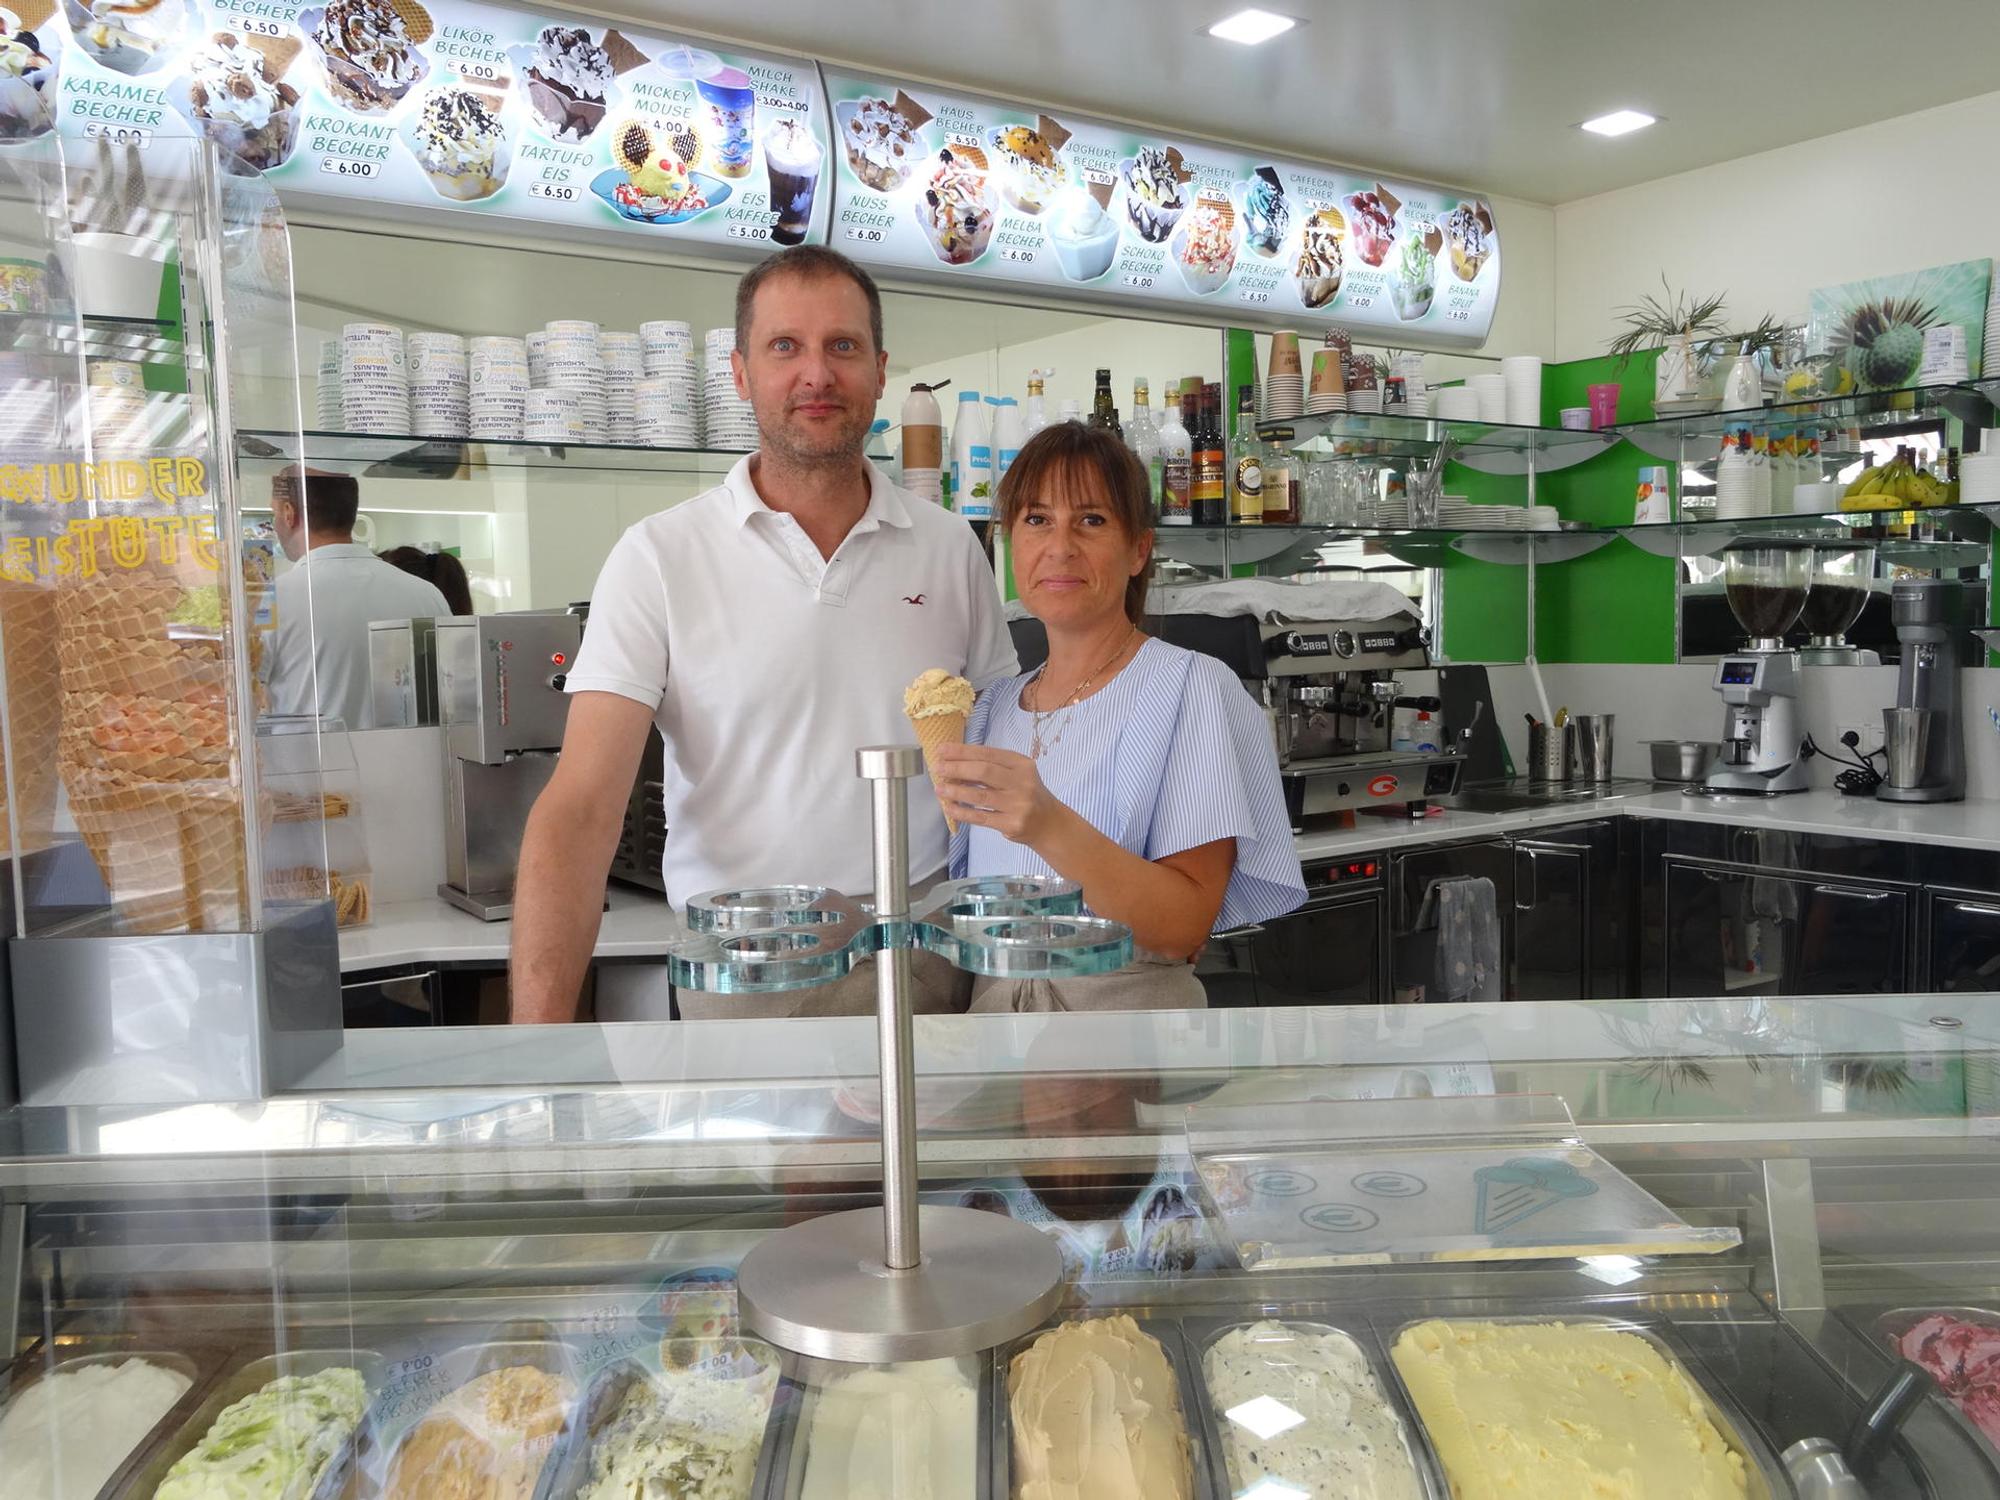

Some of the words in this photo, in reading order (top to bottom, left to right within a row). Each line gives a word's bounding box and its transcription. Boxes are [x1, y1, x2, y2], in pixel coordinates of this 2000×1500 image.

[243, 19, 279, 36] 6.50
[442, 26, 495, 46] LIKÖR
[435, 41, 506, 64] BECHER
[460, 63, 494, 79] 6.00
[747, 66, 793, 82] MILCH
[63, 76, 167, 106] KARAMEL
[632, 82, 692, 102] MICKEY
[749, 80, 796, 97] SHAKE
[72, 99, 163, 126] BECHER
[634, 100, 693, 119] MOUSE
[940, 105, 975, 120] HAUS
[305, 115, 398, 141] KROKANT
[653, 119, 683, 134] 4.00
[935, 118, 986, 135] BECHER
[312, 136, 390, 160] BECHER
[956, 135, 978, 146] 6.50
[520, 144, 594, 167] TARTUFO
[1065, 142, 1118, 160] JOGHURT
[323, 159, 333, 170] €
[339, 162, 372, 176] 6.00
[1072, 156, 1118, 173] BECHER
[1181, 160, 1236, 179] SPAGHETTI
[542, 166, 570, 181] EIS
[1090, 173, 1111, 184] 6.00
[1191, 175, 1233, 191] BECHER
[544, 185, 573, 200] 6.50
[741, 192, 766, 207] EIS
[1297, 186, 1334, 201] BECHER
[849, 195, 889, 211] NUSS
[724, 207, 780, 226] KAFFEE
[841, 210, 896, 228] BECHER
[740, 227, 768, 240] 5.00
[1001, 217, 1043, 234] MELBA
[857, 230, 882, 242] 6.00
[996, 232, 1046, 249] BECHER
[1010, 250, 1034, 262] 6.00
[1121, 245, 1166, 260] SCHOKO
[1119, 260, 1164, 275] BECHER
[1132, 276, 1153, 287] 6.00
[1239, 276, 1279, 290] BECHER
[1346, 282, 1383, 296] BECHER
[1249, 292, 1268, 303] 6.50
[1448, 284, 1481, 297] BANANA
[1449, 297, 1474, 309] SPLIT
[0, 456, 207, 505] WUNDER
